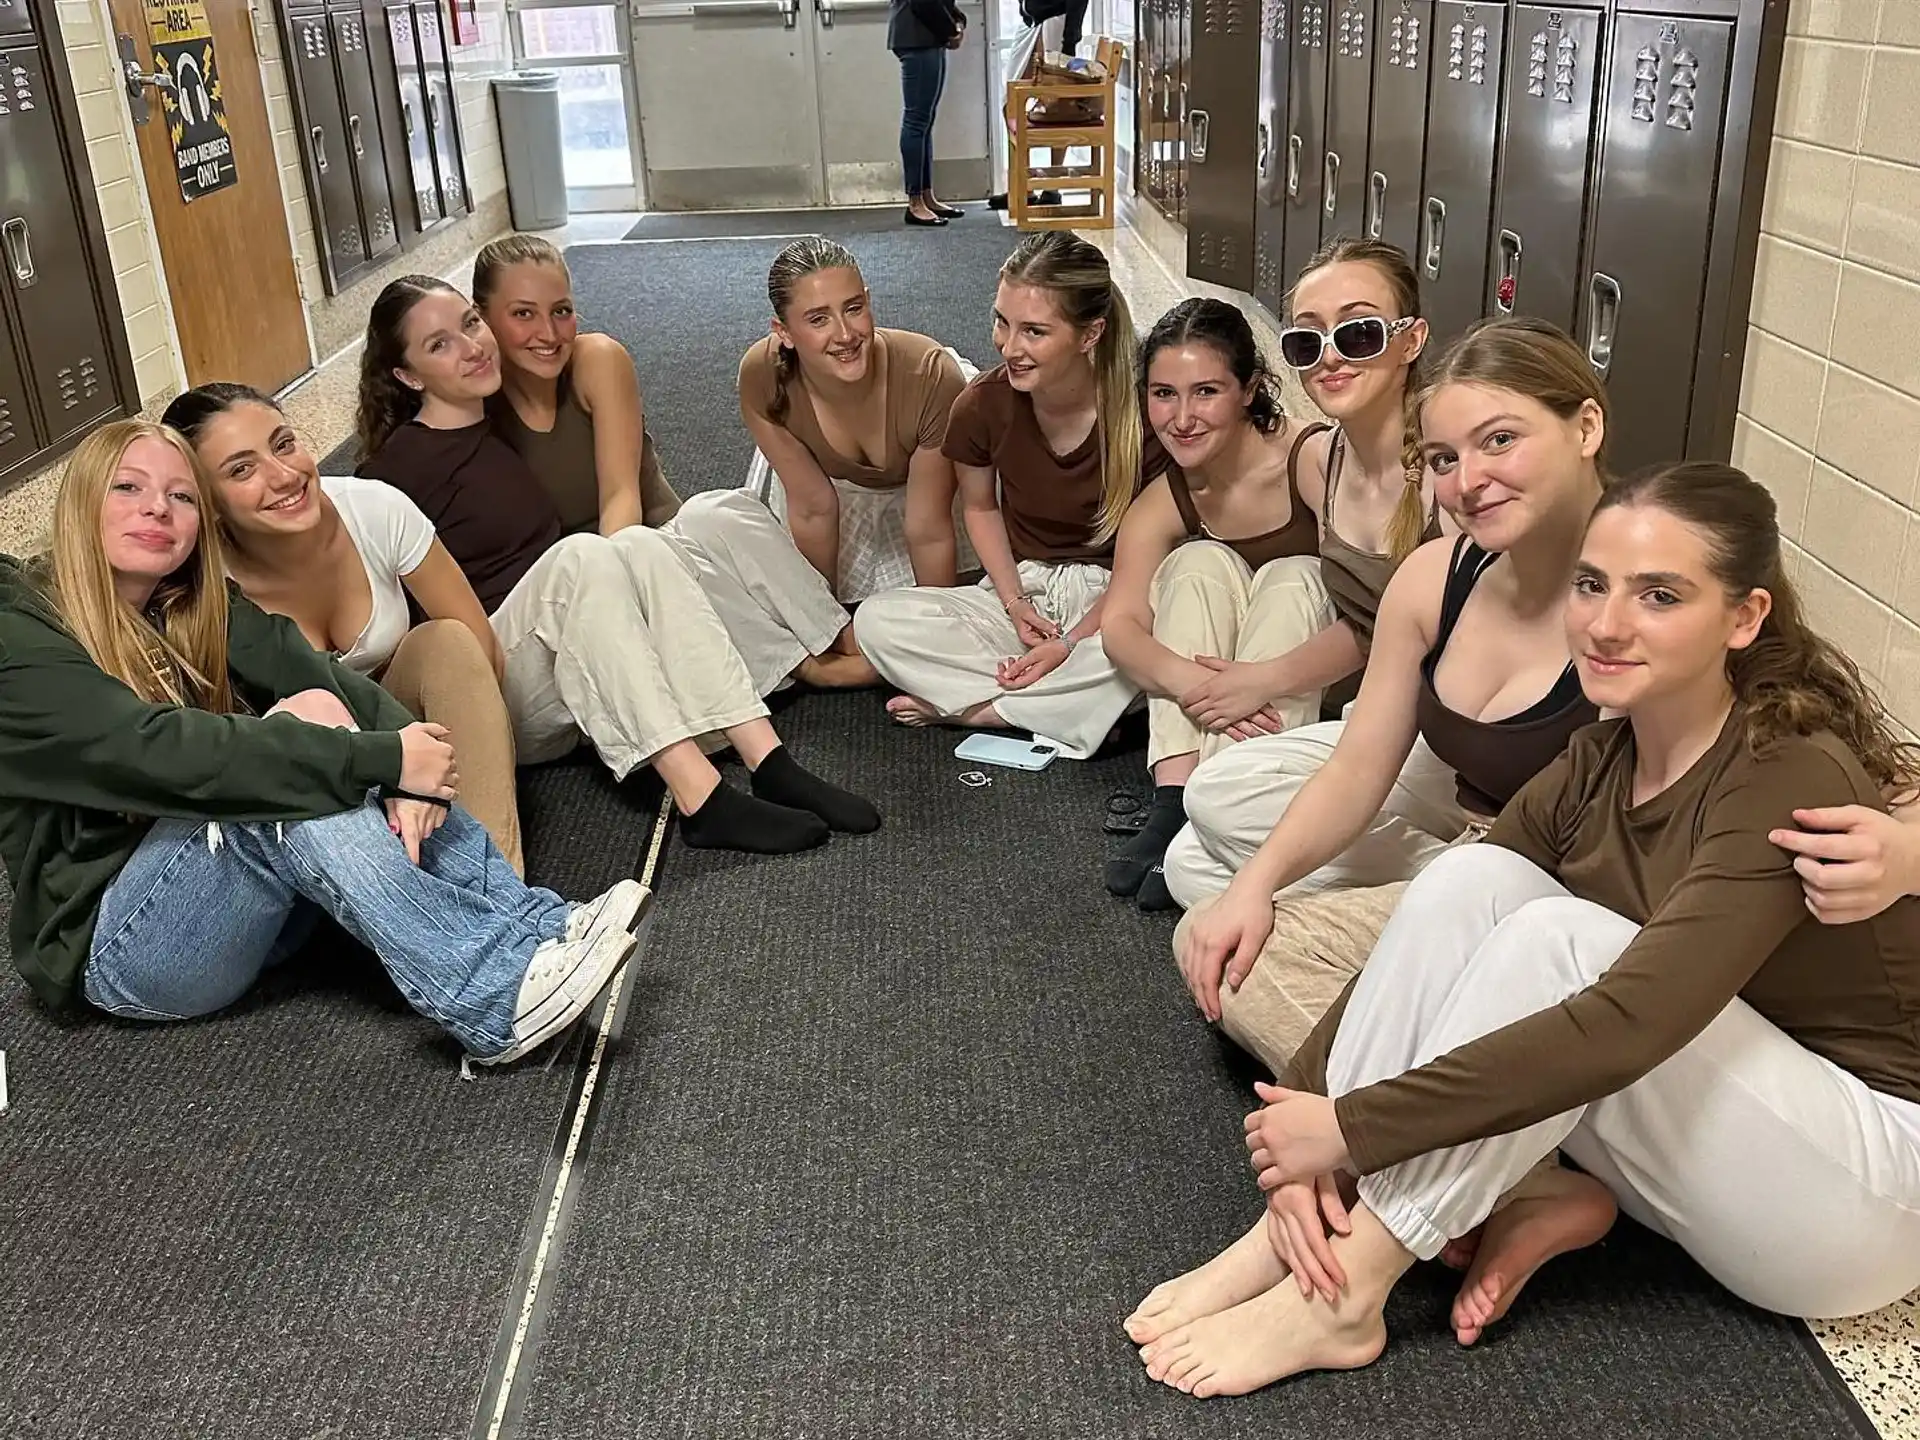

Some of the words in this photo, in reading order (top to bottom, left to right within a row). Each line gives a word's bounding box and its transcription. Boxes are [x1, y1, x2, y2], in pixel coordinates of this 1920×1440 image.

[167, 8, 192, 33] AREA
[177, 146, 198, 169] BAND
[198, 137, 230, 162] MEMBERS
[197, 160, 220, 188] ONLY
